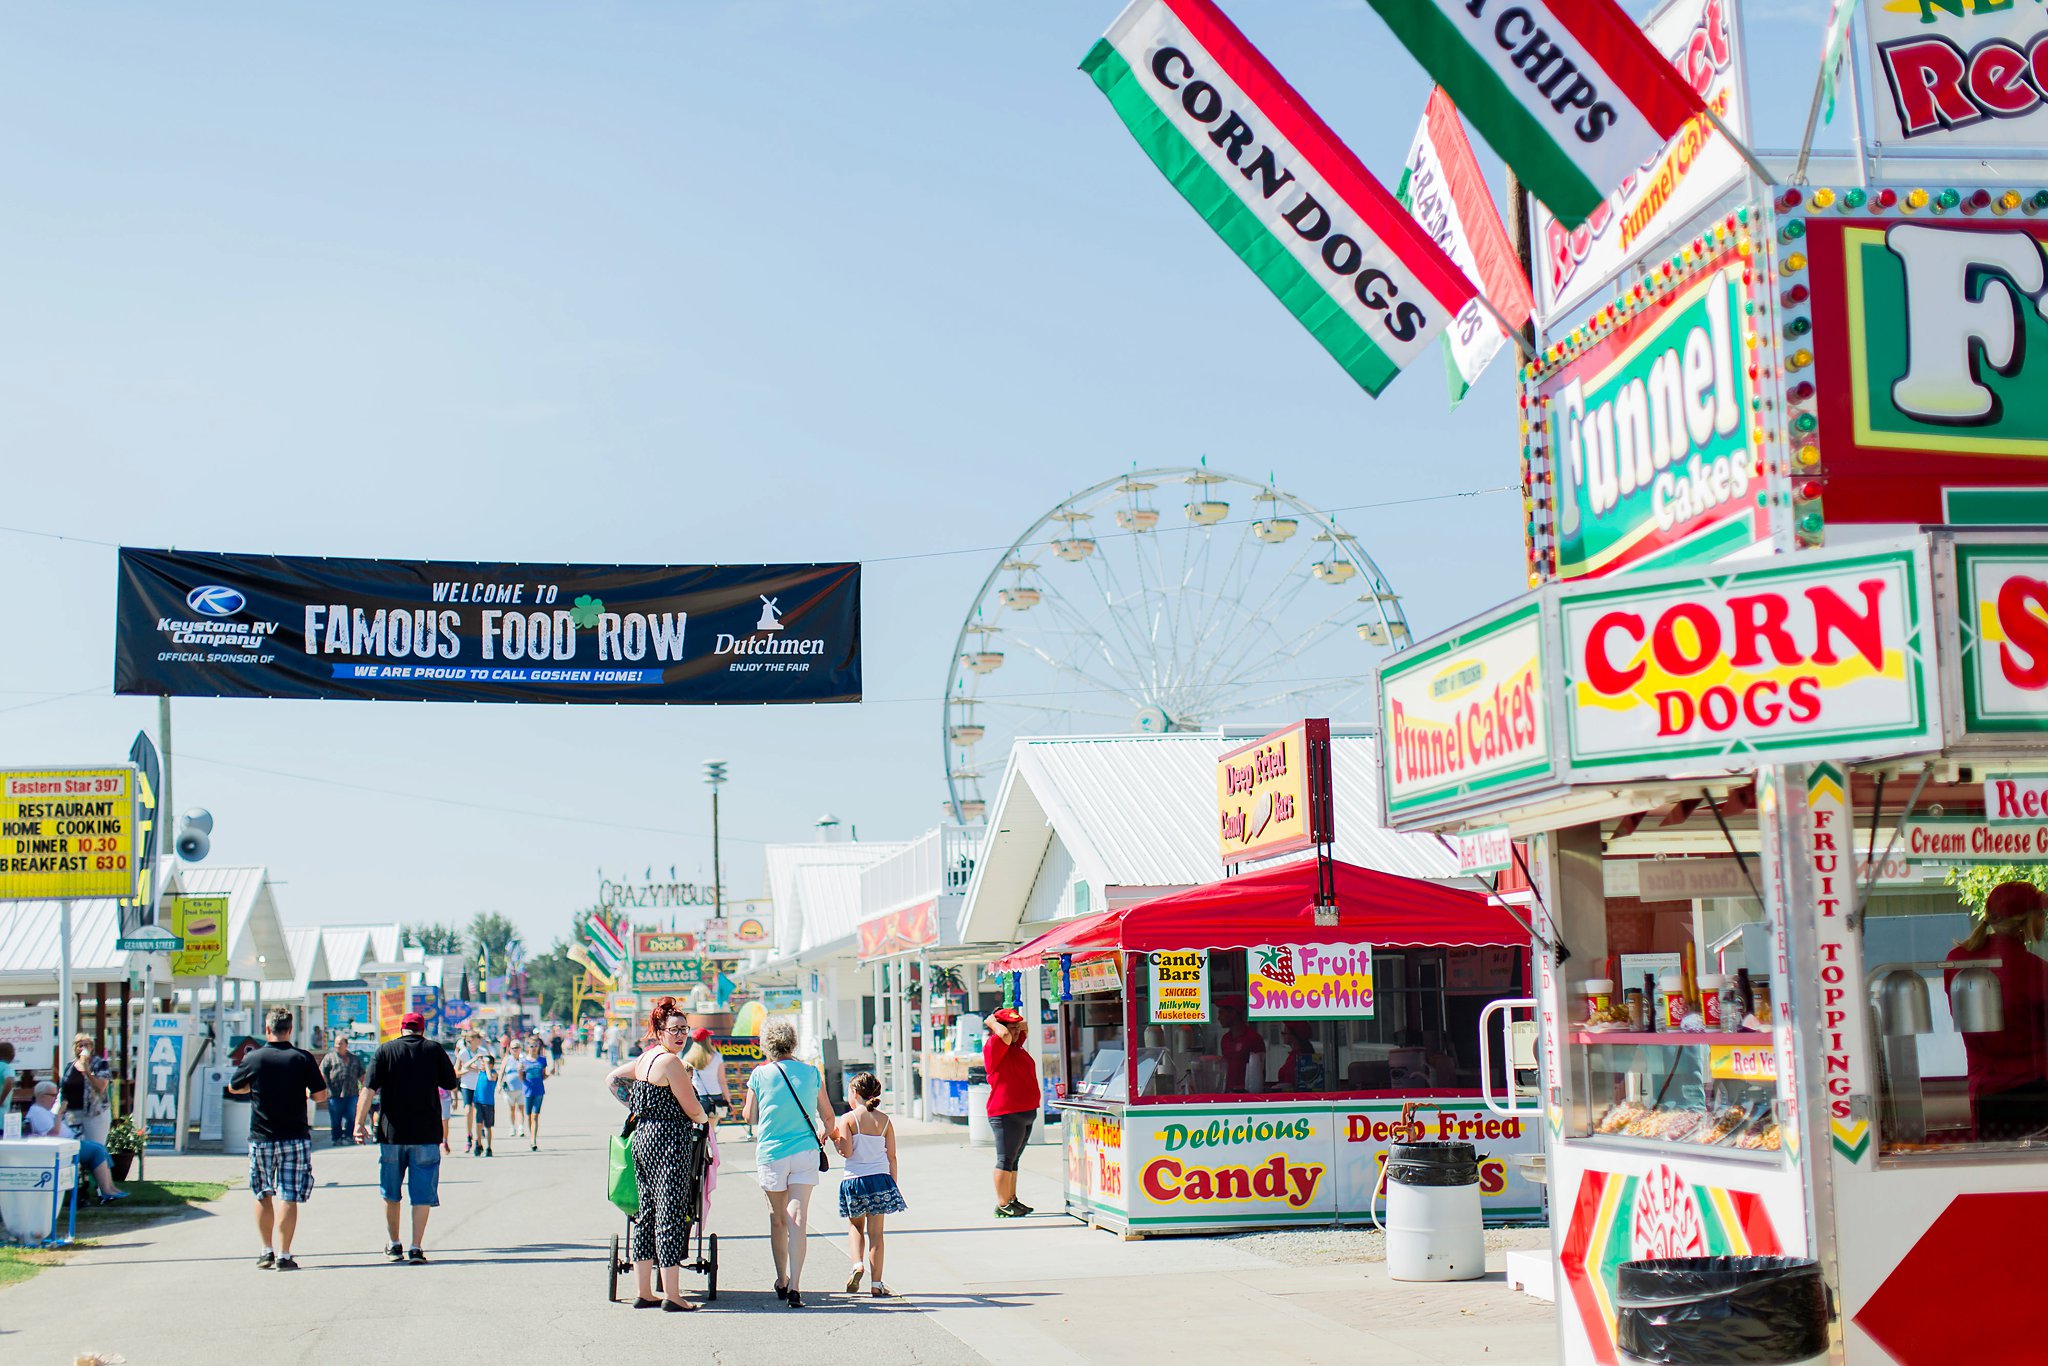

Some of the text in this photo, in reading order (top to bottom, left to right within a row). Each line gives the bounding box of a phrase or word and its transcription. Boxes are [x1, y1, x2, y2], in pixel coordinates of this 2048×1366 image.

[1494, 6, 1618, 143] CHIPS
[1152, 46, 1426, 342] CORN DOGS
[1620, 159, 1675, 253] Funnel
[1555, 269, 1740, 536] Funnel
[1652, 448, 1749, 532] Cakes
[432, 582, 558, 604] WELCOME TO
[156, 617, 279, 635] Keystone RV
[172, 631, 262, 649] Company
[304, 604, 687, 661] FAMOUS FOOD ROW
[1585, 578, 1885, 696] CORN
[157, 652, 275, 664] OFFICIAL SPONSOR OF
[713, 633, 824, 656] Dutchmen
[354, 666, 643, 682] WE ARE PROUD TO CALL GOSHEN HOME!
[729, 663, 810, 672] ENJOY THE FAIR
[1654, 676, 1821, 737] DOGS
[1392, 669, 1536, 785] Funnel Cakes
[1225, 741, 1287, 796] Deep Fried
[12, 778, 119, 794] Eastern Star 397
[18, 801, 114, 818] RESTAURANT
[1222, 790, 1295, 843] Candy Bars
[2, 819, 121, 836] HOME COOKING
[1911, 827, 1966, 854] Cream
[1971, 827, 2031, 853] Cheese
[16, 837, 117, 853] DINNER 10.30
[1460, 832, 1508, 869] Red Velvet
[0, 856, 87, 872] BREAKFAST
[600, 879, 727, 908] CRAZY MOUSE
[155, 941, 176, 949] STREET
[650, 942, 684, 951] DOGS
[648, 961, 686, 971] STEAK
[1149, 952, 1207, 969] Candy
[1158, 967, 1201, 981] Bars
[1298, 947, 1370, 976] Fruit
[1814, 810, 1852, 1119] FRUIT TOPPINGS
[635, 970, 699, 982] SAUSAGE
[1165, 987, 1198, 997] SNICKERS
[1248, 979, 1374, 1010] Smoothie
[152, 1018, 178, 1028] ATM
[1154, 1010, 1206, 1020] Musketeers
[1733, 1051, 1776, 1073] Red Ve
[146, 1037, 177, 1120] ATM
[1101, 1116, 1122, 1149] Fried
[1163, 1116, 1311, 1152] Delicious
[1437, 1112, 1521, 1141] Fried
[1099, 1152, 1122, 1195] Bars
[1143, 1157, 1323, 1206] Candy
[1635, 1163, 1705, 1258] THE BEST
